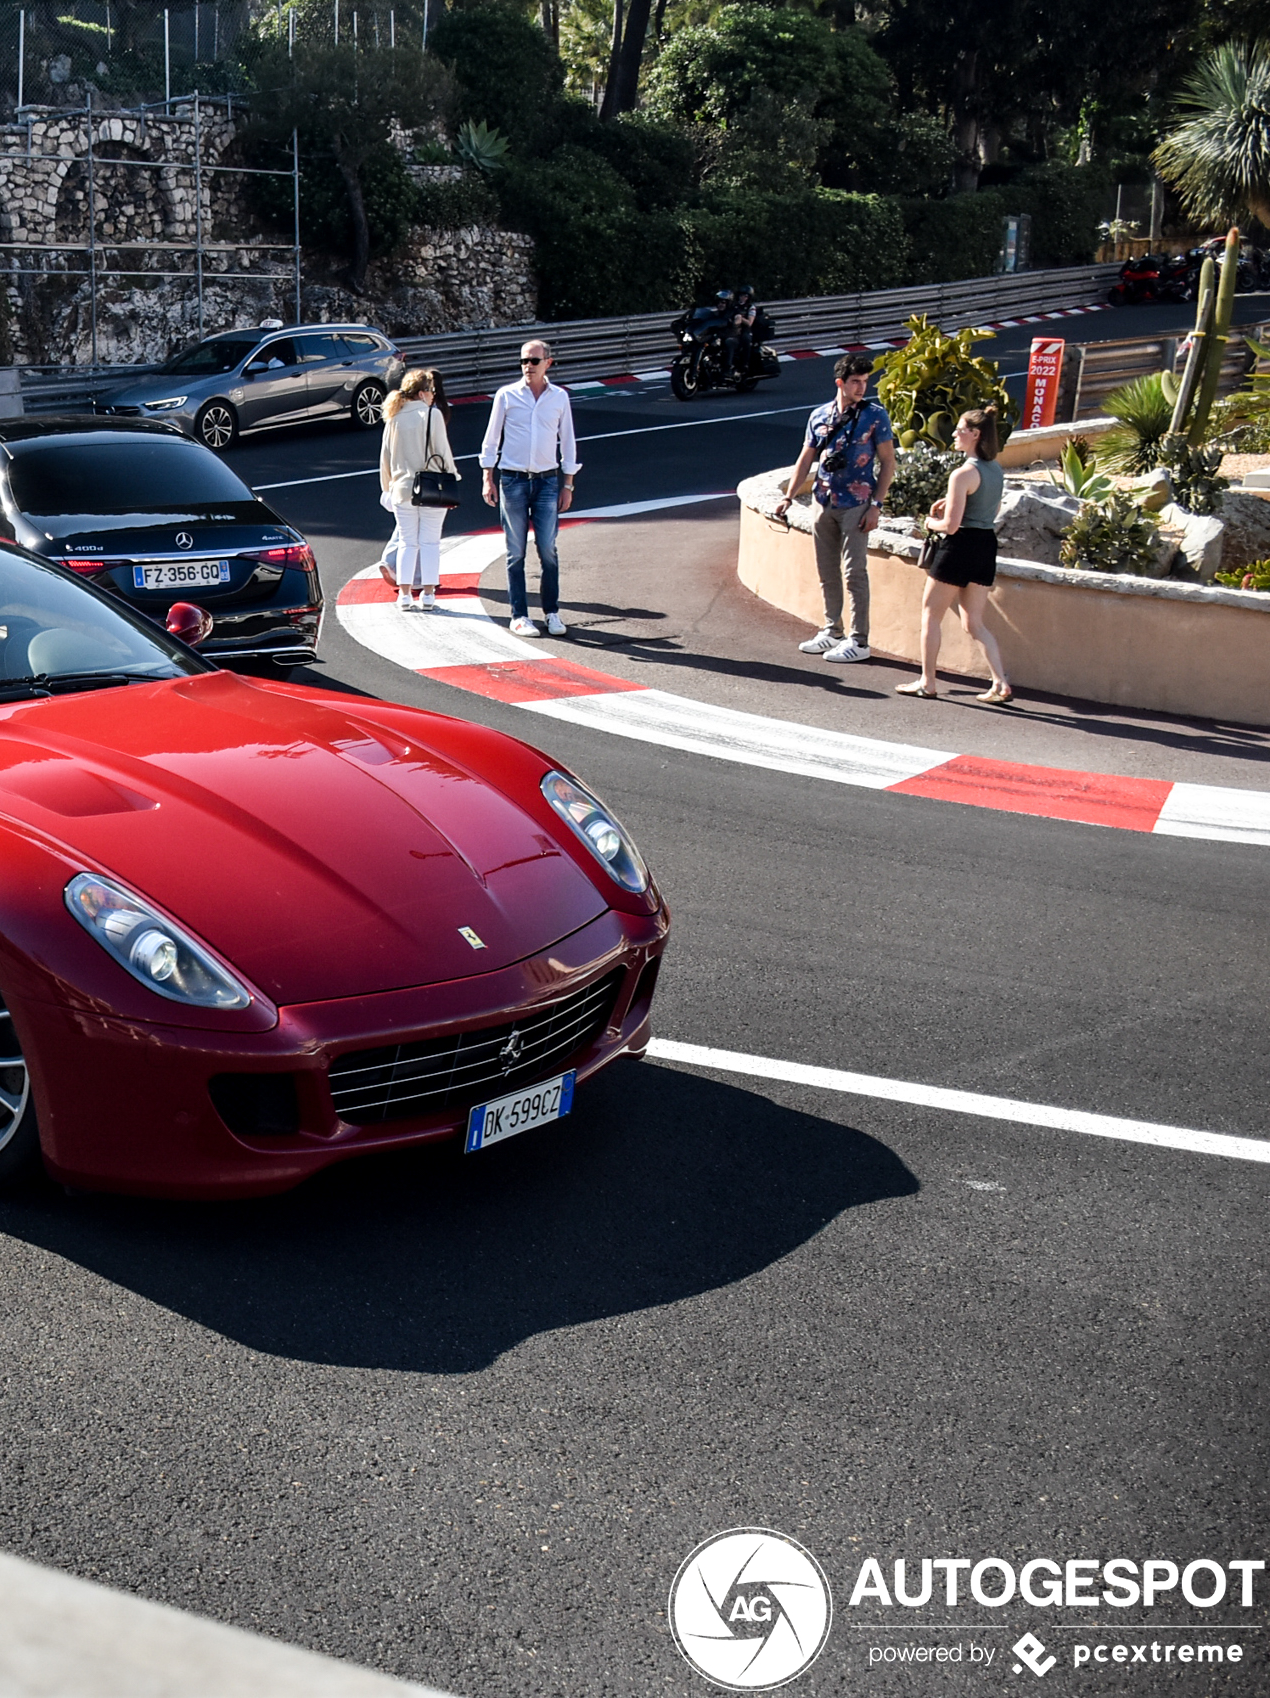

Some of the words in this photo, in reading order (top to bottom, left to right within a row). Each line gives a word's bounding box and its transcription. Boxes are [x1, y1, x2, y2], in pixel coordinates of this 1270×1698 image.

[1032, 356, 1056, 364] E-PRIX
[1031, 365, 1055, 376] 2022
[144, 564, 219, 584] FZ-356-GQ
